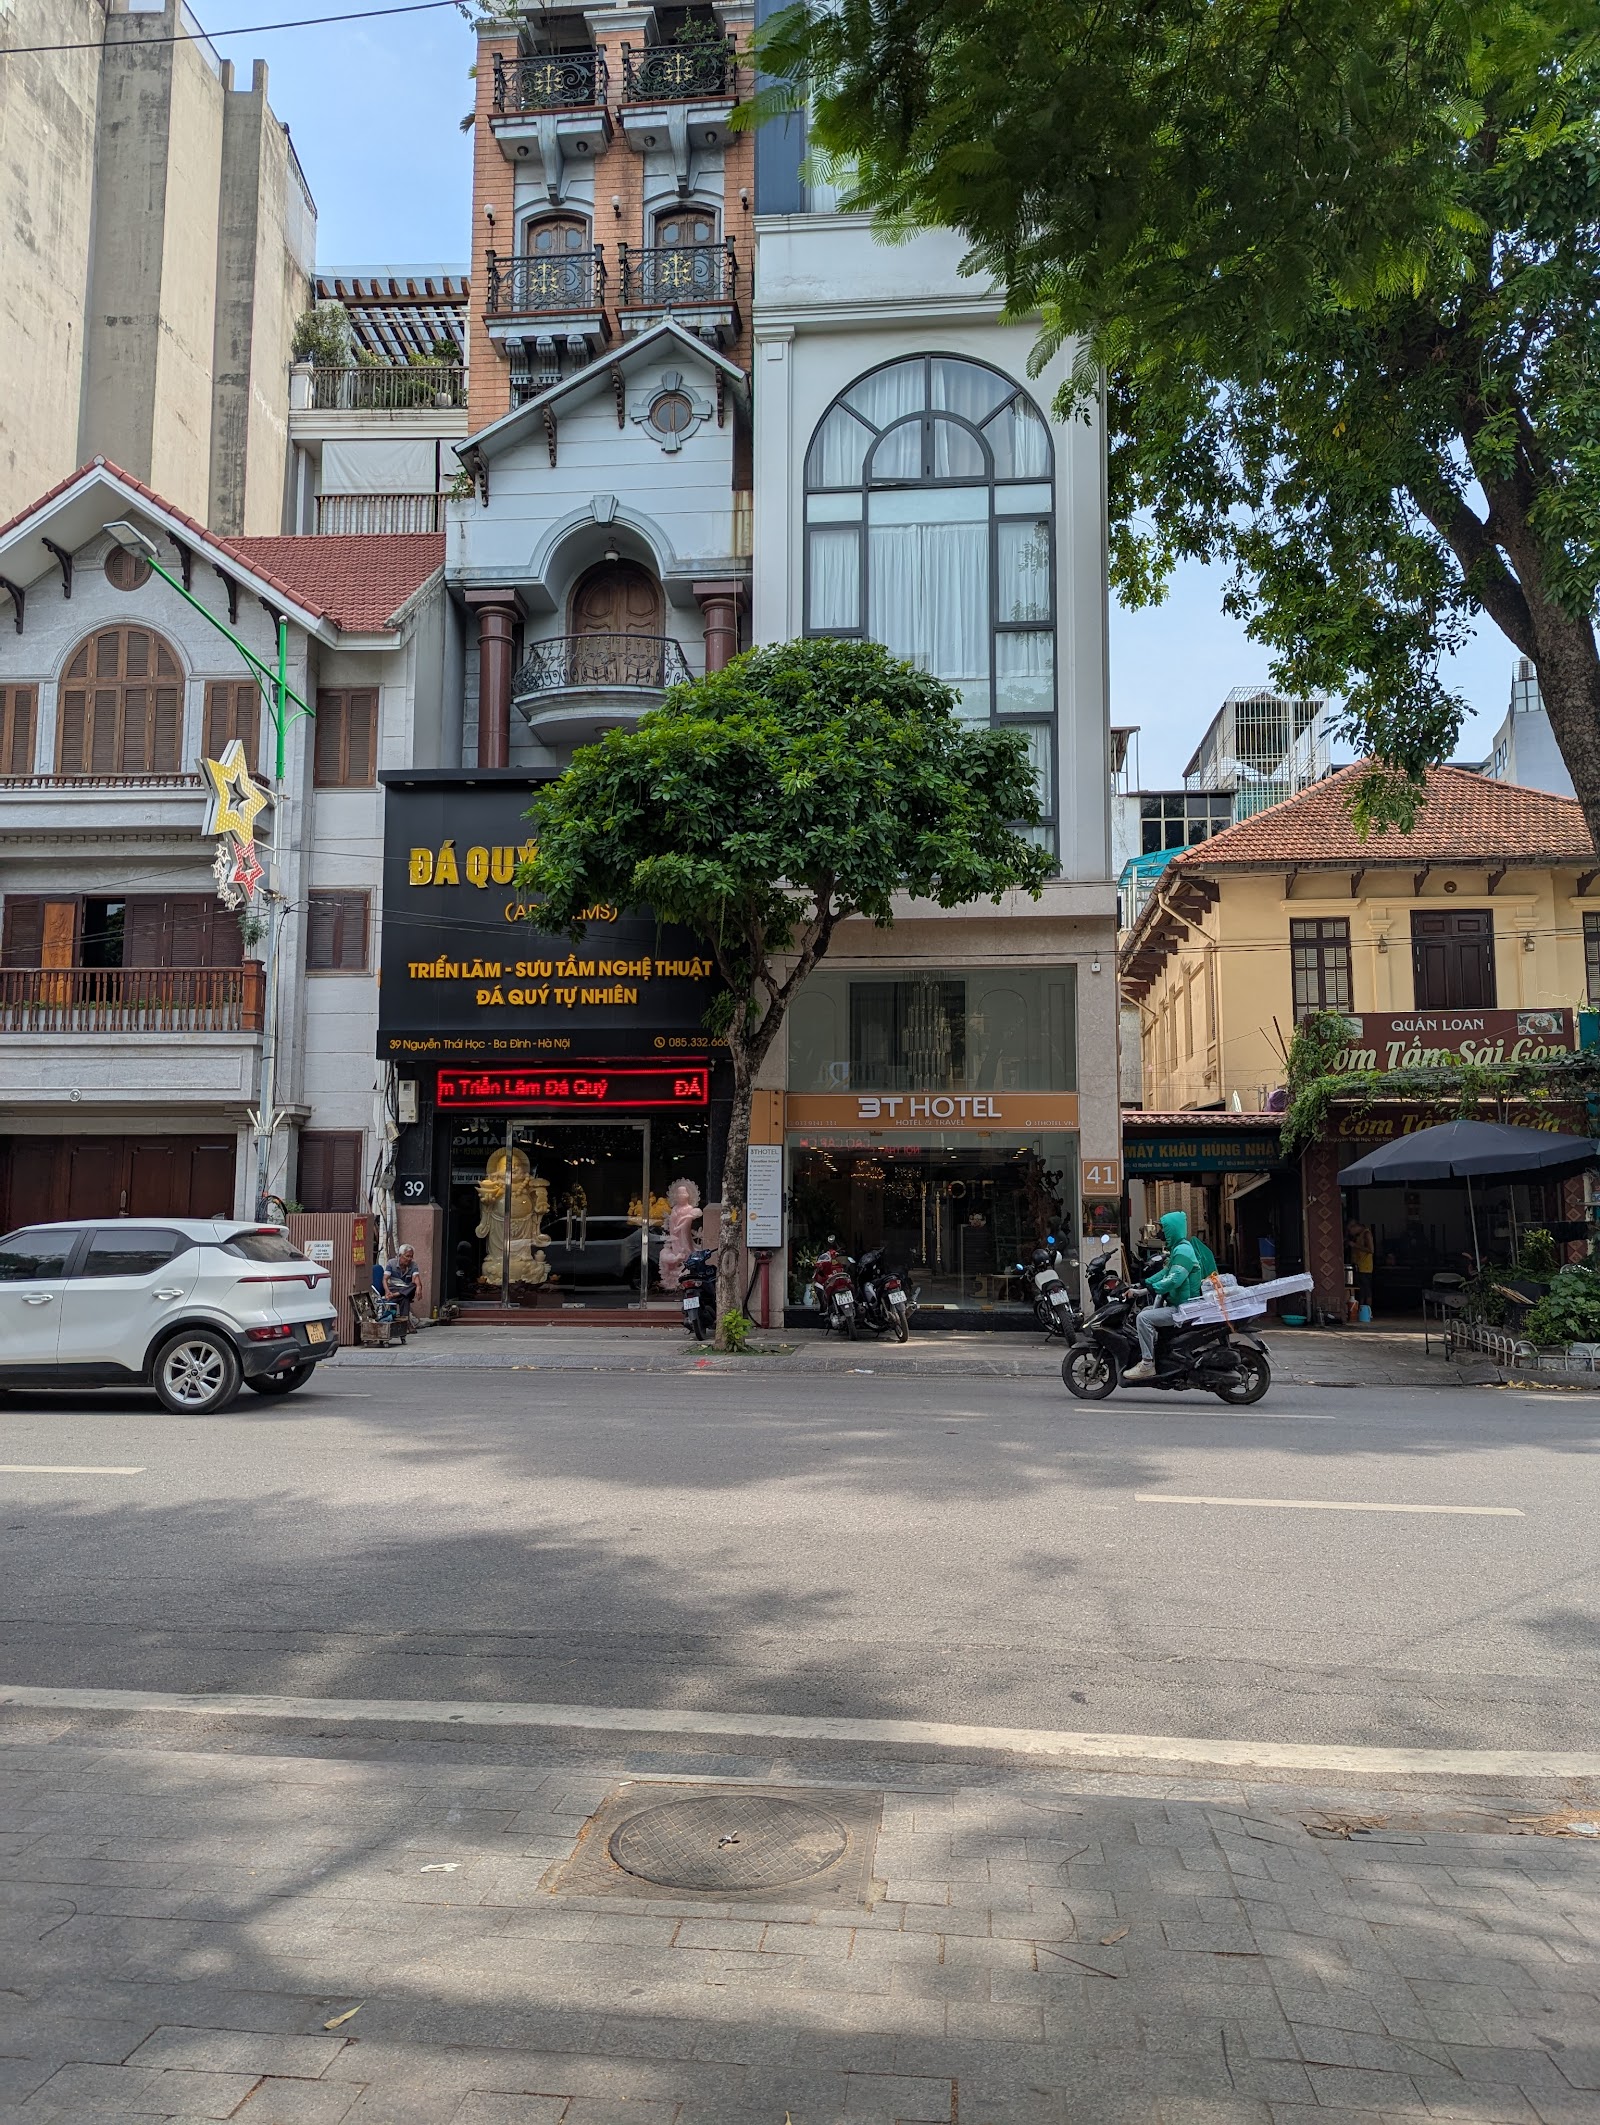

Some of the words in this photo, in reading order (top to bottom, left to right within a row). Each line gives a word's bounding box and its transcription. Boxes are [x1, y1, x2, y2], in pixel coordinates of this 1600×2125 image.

[408, 839, 460, 886] ĐÁ
[408, 954, 460, 978] TRIỂN
[462, 958, 501, 978] LÃM
[515, 959, 552, 977] SƯU
[555, 953, 595, 976] TẦM
[599, 956, 652, 981] NGHỆ
[655, 956, 713, 981] THUẬT
[476, 984, 505, 1005] ĐÁ
[508, 982, 549, 1005] QUÝ
[553, 985, 579, 1008] TỰ
[581, 984, 637, 1004] NHIÊN
[1391, 1017, 1437, 1032] QUÁN
[1442, 1019, 1485, 1031] LOAN
[389, 1039, 401, 1049] 39
[403, 1038, 441, 1051] Nguyễn
[444, 1039, 463, 1049] Thái
[465, 1040, 485, 1050] Học
[493, 1039, 507, 1049] Ba
[510, 1038, 531, 1049] Đình
[538, 1037, 552, 1048] Hà
[554, 1038, 570, 1050] Nội
[1459, 1037, 1504, 1066] Sài
[674, 1077, 701, 1096] ĐÁ
[857, 1097, 904, 1118] 3T
[910, 1096, 1002, 1118] HOTEL
[1123, 1143, 1154, 1159] MÁY
[1159, 1141, 1197, 1158] KHÂU
[1086, 1165, 1116, 1185] 41
[403, 1180, 425, 1197] 39
